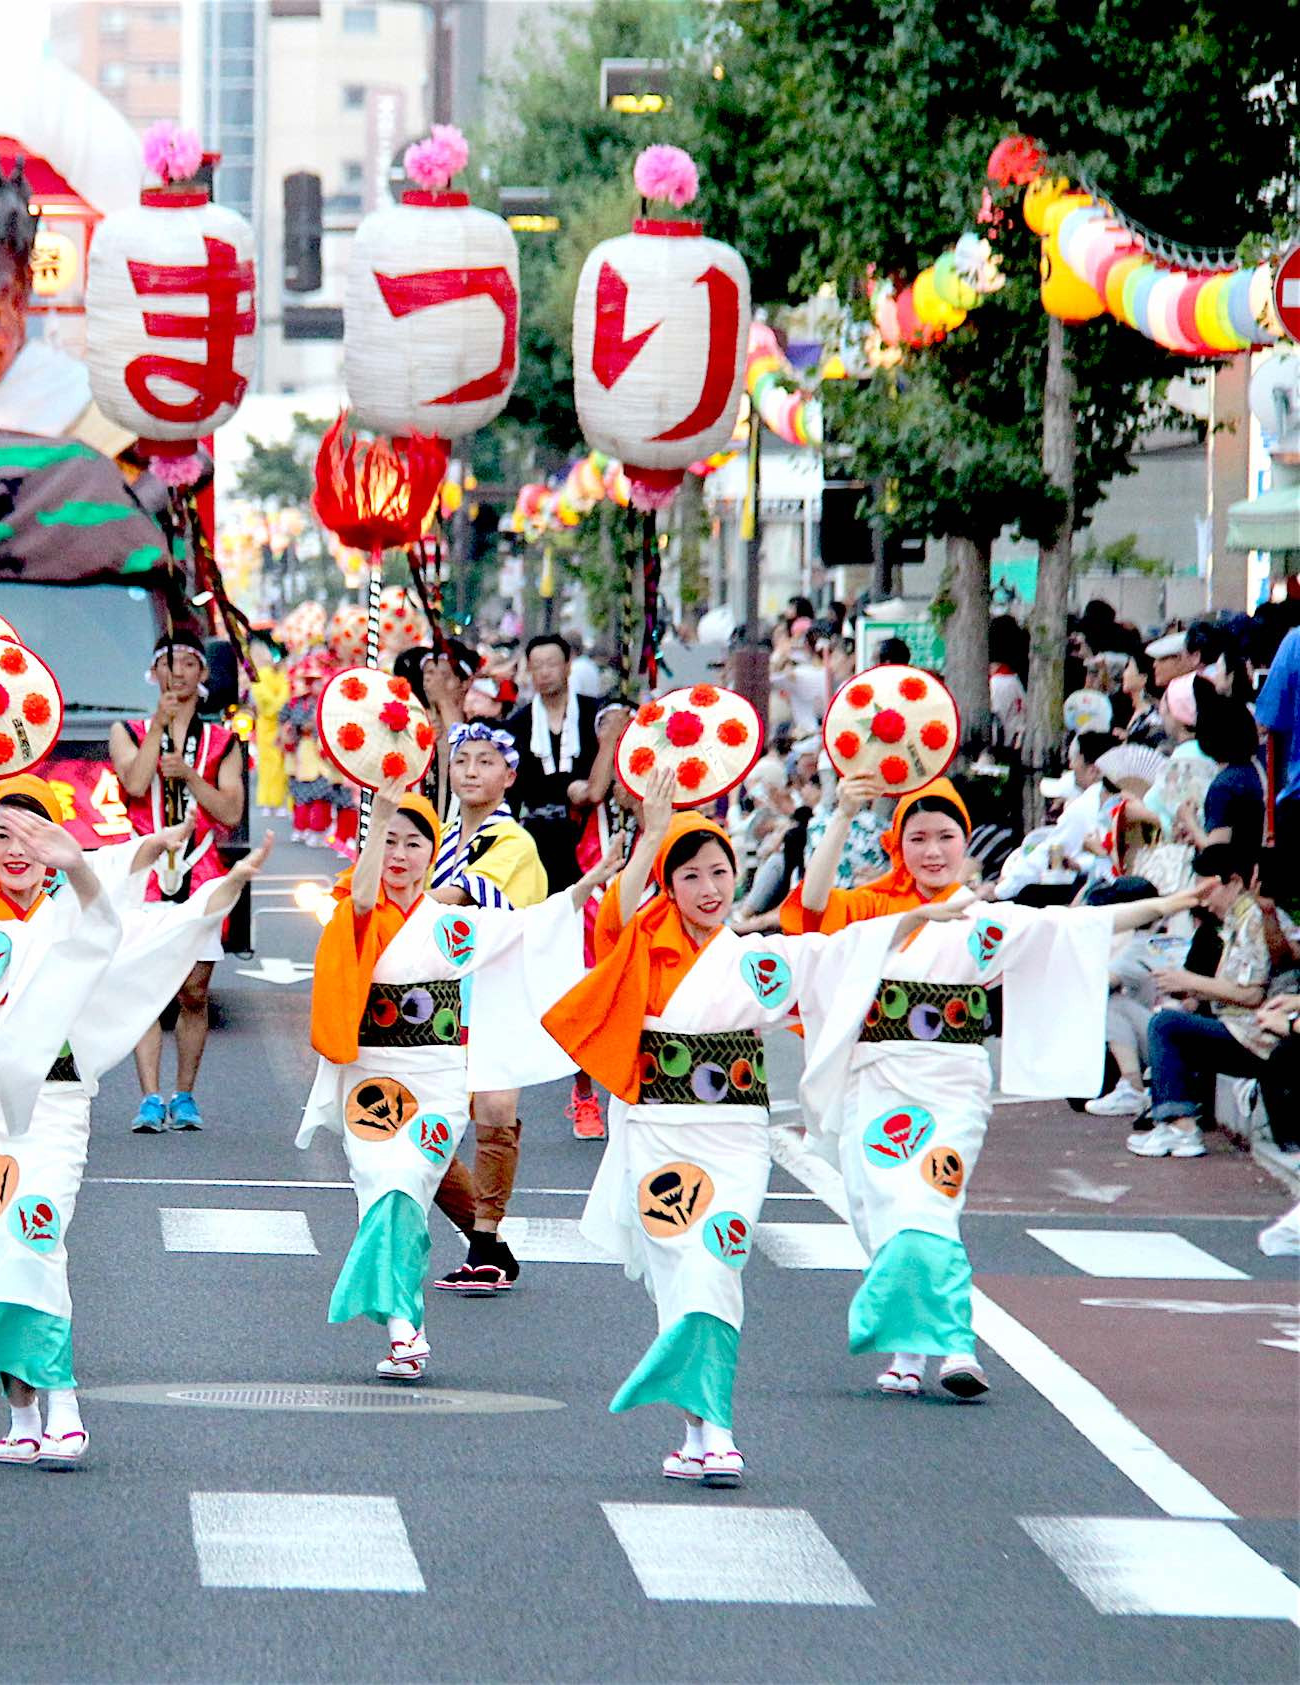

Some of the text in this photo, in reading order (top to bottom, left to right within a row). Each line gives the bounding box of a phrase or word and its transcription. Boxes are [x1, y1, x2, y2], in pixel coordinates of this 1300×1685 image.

[125, 236, 256, 423] ま
[374, 266, 519, 405] つ
[592, 262, 740, 442] り
